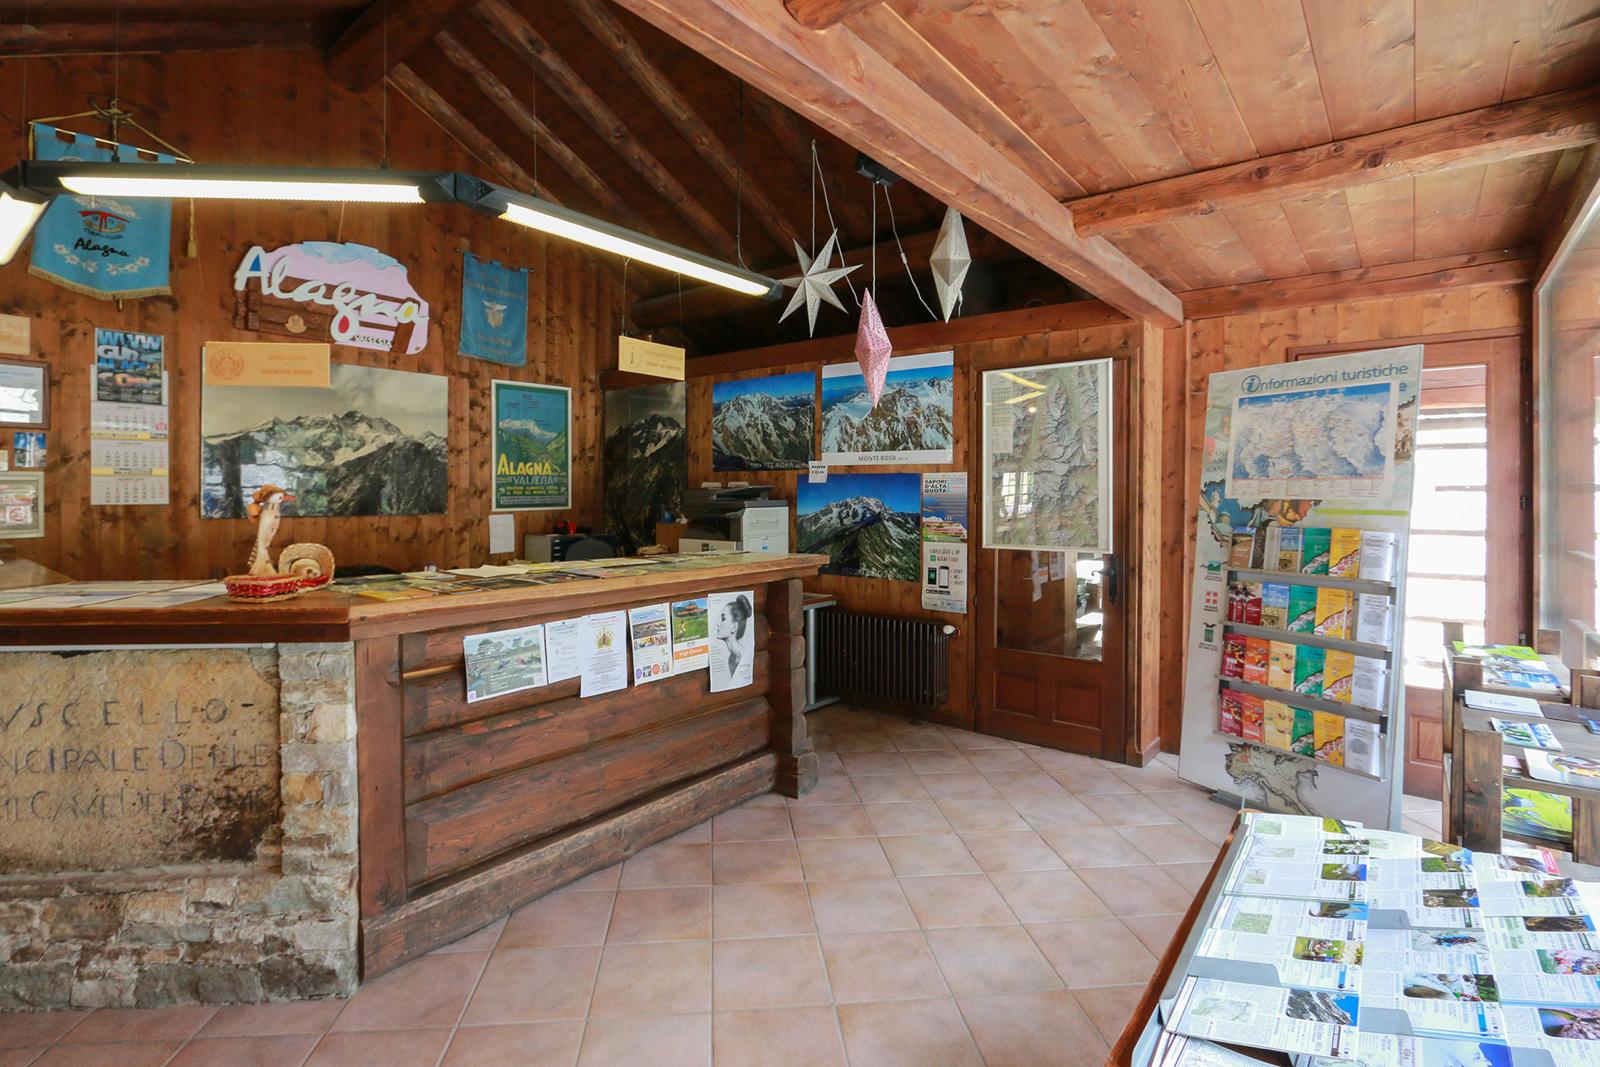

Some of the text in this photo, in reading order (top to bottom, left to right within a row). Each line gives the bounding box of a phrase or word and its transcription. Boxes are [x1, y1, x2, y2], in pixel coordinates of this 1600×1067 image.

[74, 237, 130, 257] Alagna
[233, 245, 429, 343] Alagna
[1241, 362, 1408, 394] informazioni turistiche
[496, 453, 552, 476] ALAGNA
